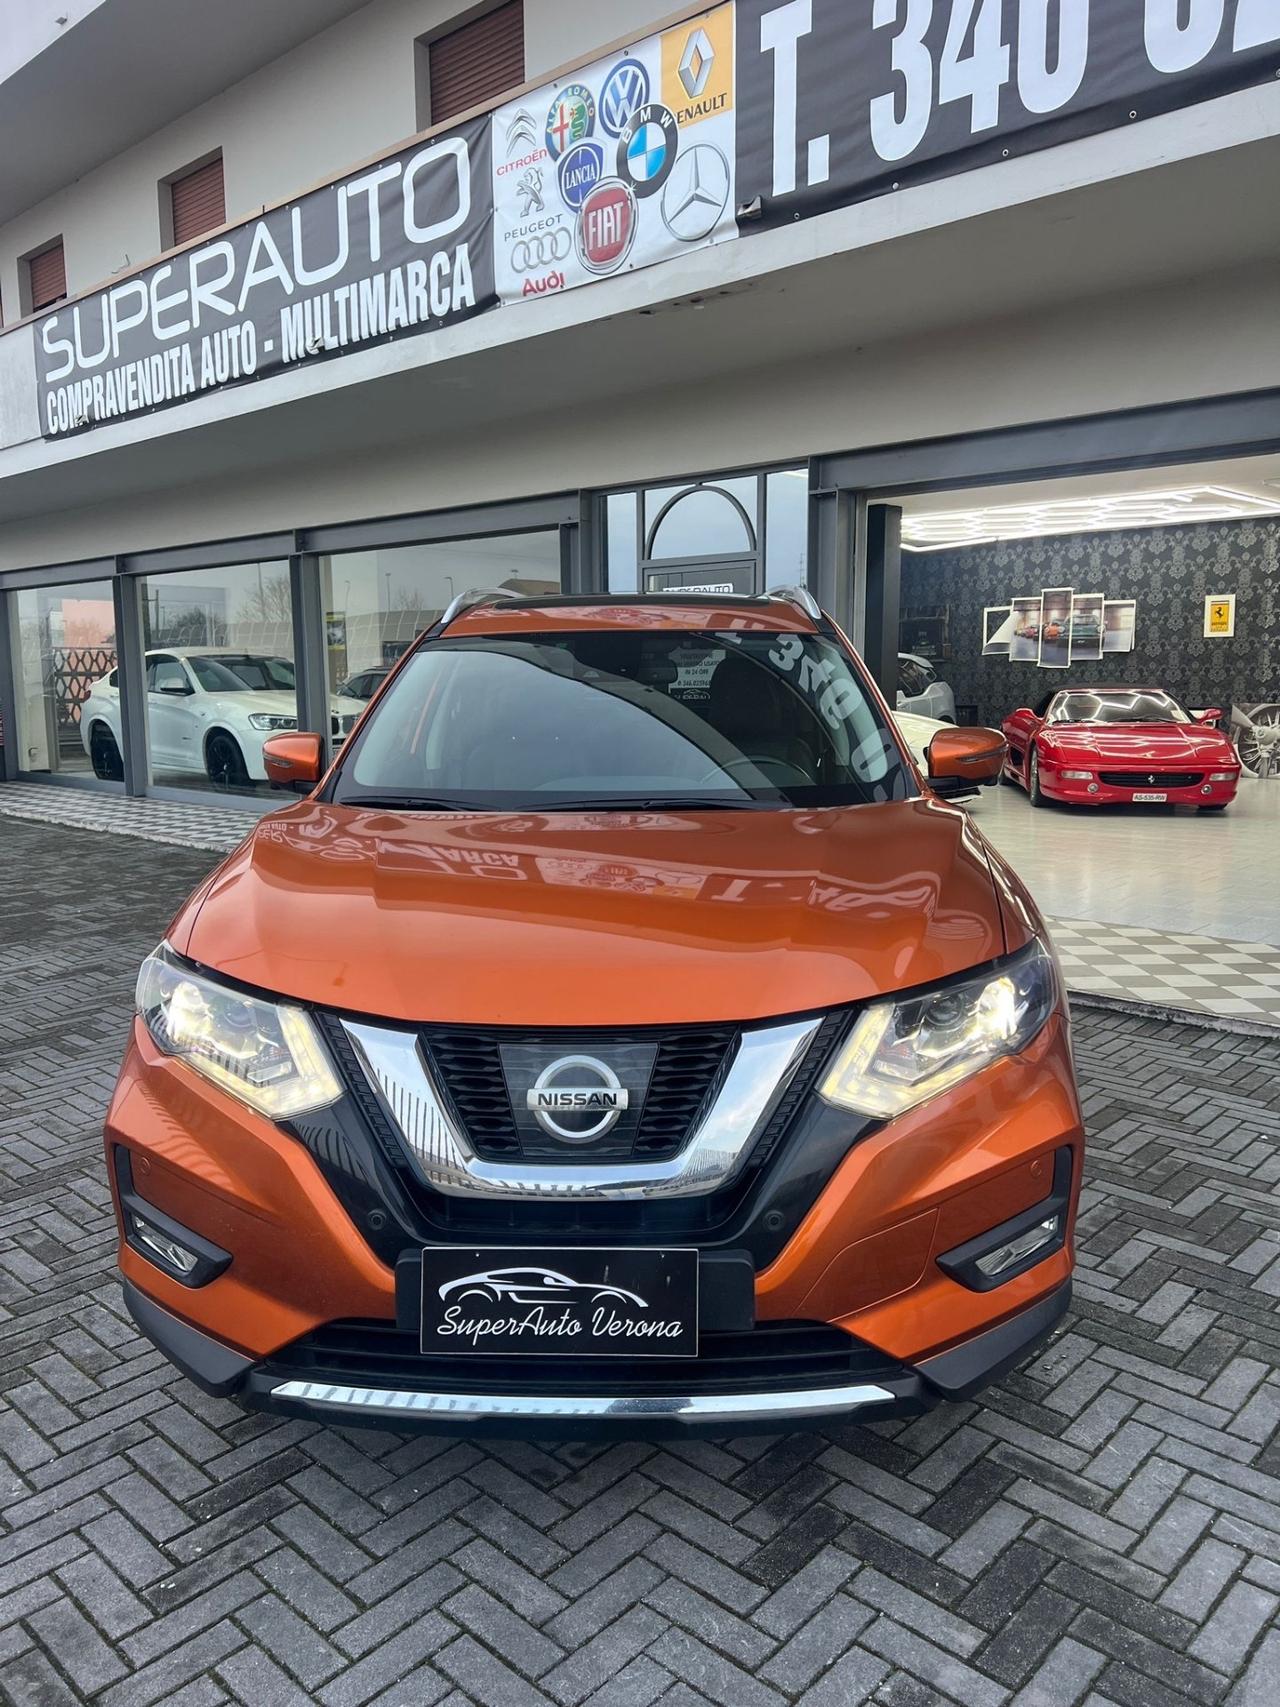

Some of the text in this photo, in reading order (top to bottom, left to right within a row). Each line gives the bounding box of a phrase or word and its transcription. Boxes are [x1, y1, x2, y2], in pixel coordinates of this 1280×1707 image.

[568, 87, 594, 117] ROMEO
[677, 93, 727, 124] ENAULT
[761, 0, 829, 198] T.
[622, 108, 673, 144] BMW
[565, 164, 596, 189] LANCIA
[503, 213, 563, 242] PEUGEOT
[588, 201, 625, 250] FIAT
[42, 137, 471, 383] SUPERAUTO
[522, 270, 566, 297] Audi
[46, 343, 196, 436] COMPRAVENDITA
[201, 320, 258, 388] AUTO
[280, 243, 477, 364] MULTIMARCA
[538, 1091, 618, 1107] NISSAN
[437, 1304, 684, 1347] SuperAuto Verona
